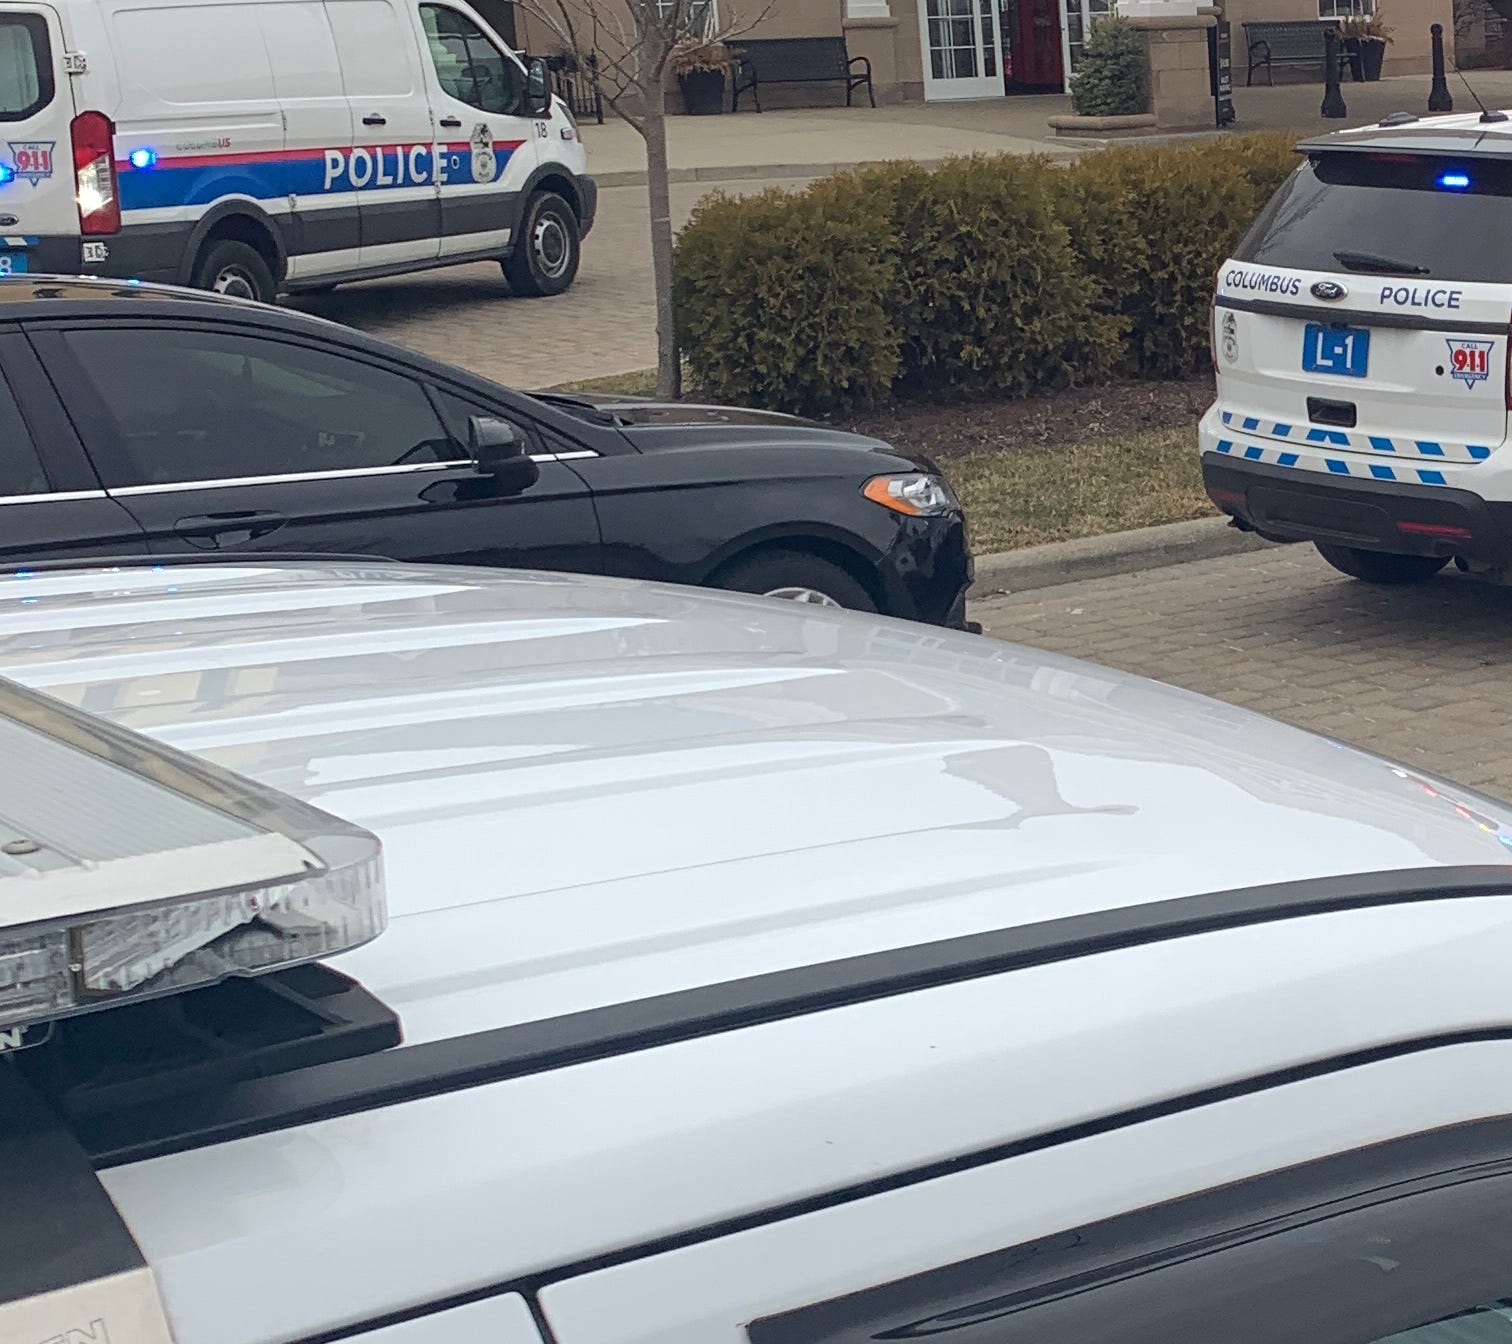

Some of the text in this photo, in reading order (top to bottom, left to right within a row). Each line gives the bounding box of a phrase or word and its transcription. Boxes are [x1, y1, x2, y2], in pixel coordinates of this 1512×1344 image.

[535, 122, 547, 138] 18
[324, 144, 448, 190] POLICE
[1226, 270, 1301, 296] COLUMBUS
[1380, 287, 1462, 309] POLICE
[1316, 332, 1354, 369] L-1
